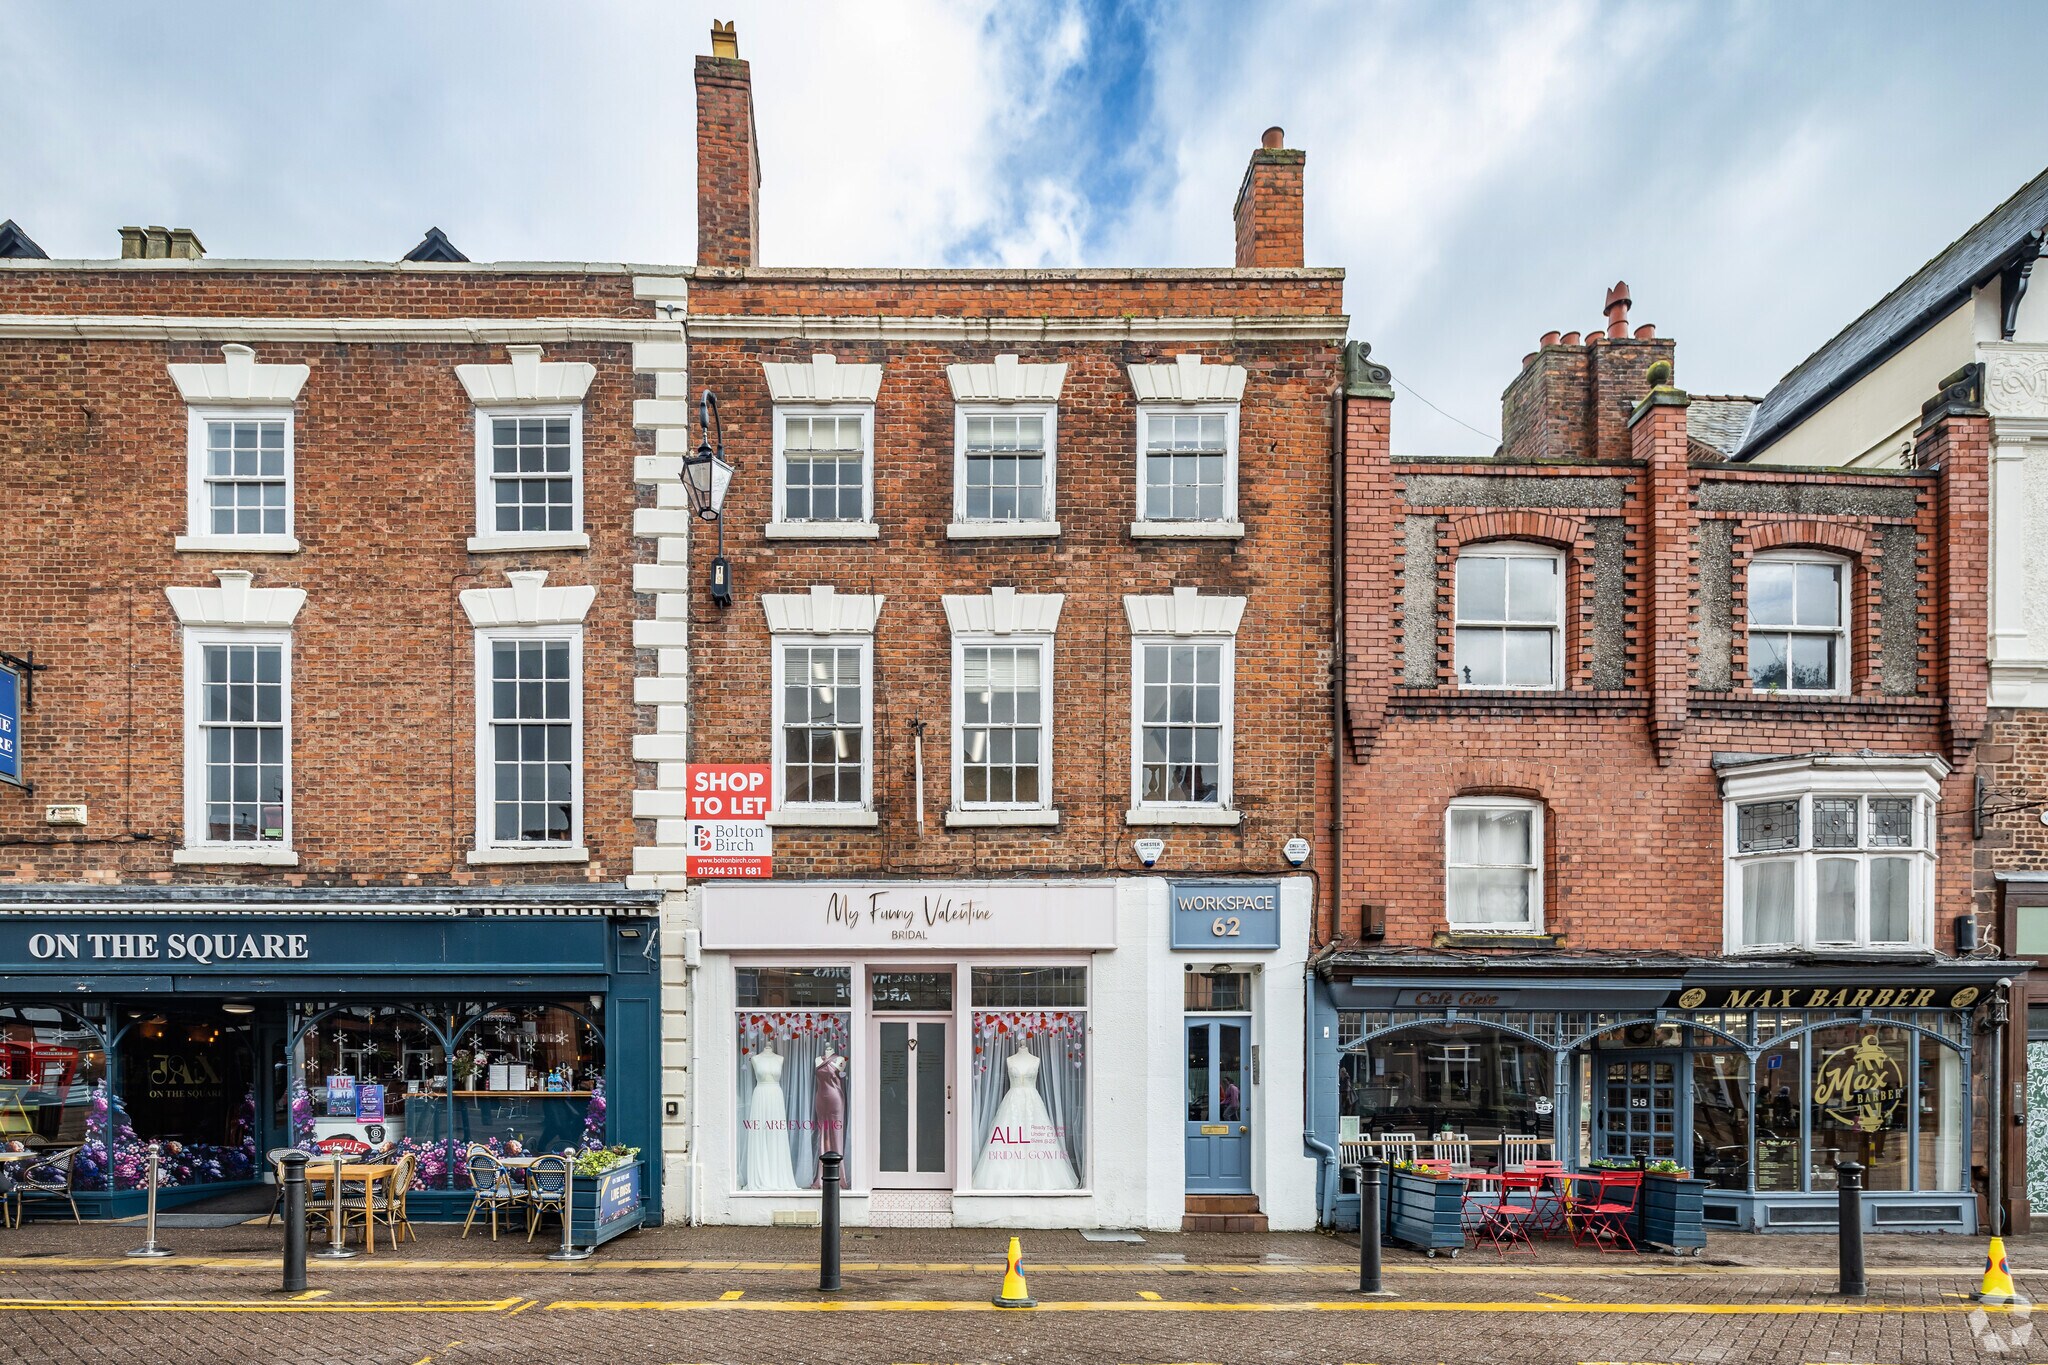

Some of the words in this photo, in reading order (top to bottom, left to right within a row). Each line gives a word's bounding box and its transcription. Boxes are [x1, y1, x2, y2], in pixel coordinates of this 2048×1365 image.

[694, 772, 764, 792] SHOP
[692, 797, 722, 814] TO
[731, 797, 766, 814] LET
[716, 825, 764, 838] Bolton
[716, 838, 754, 852] Birch
[697, 866, 725, 875] 01244
[727, 866, 743, 875] 311
[746, 866, 762, 875] 681
[826, 891, 860, 928] My
[868, 891, 914, 927] Funny
[924, 894, 994, 926] Valentine
[1178, 895, 1274, 912] WORKSPACE
[1212, 916, 1240, 937] 62
[891, 930, 928, 940] BRIDAL
[28, 933, 79, 958] ON
[88, 933, 160, 958] THE
[168, 932, 309, 964] SQUARE
[1721, 989, 1800, 1008] MAX
[1804, 988, 1936, 1007] BARBER
[330, 1078, 352, 1088] LIVE
[1814, 1065, 1888, 1104] Max
[150, 1090, 164, 1098] ON
[166, 1090, 184, 1098] THE
[1857, 1089, 1902, 1104] BARBER
[1632, 1098, 1647, 1107] 58
[742, 1120, 760, 1130] WE
[765, 1120, 786, 1130] ARE
[788, 1120, 843, 1130] EVOLVING
[990, 1126, 1030, 1144] ALL
[988, 1150, 1025, 1160] BRIDAL
